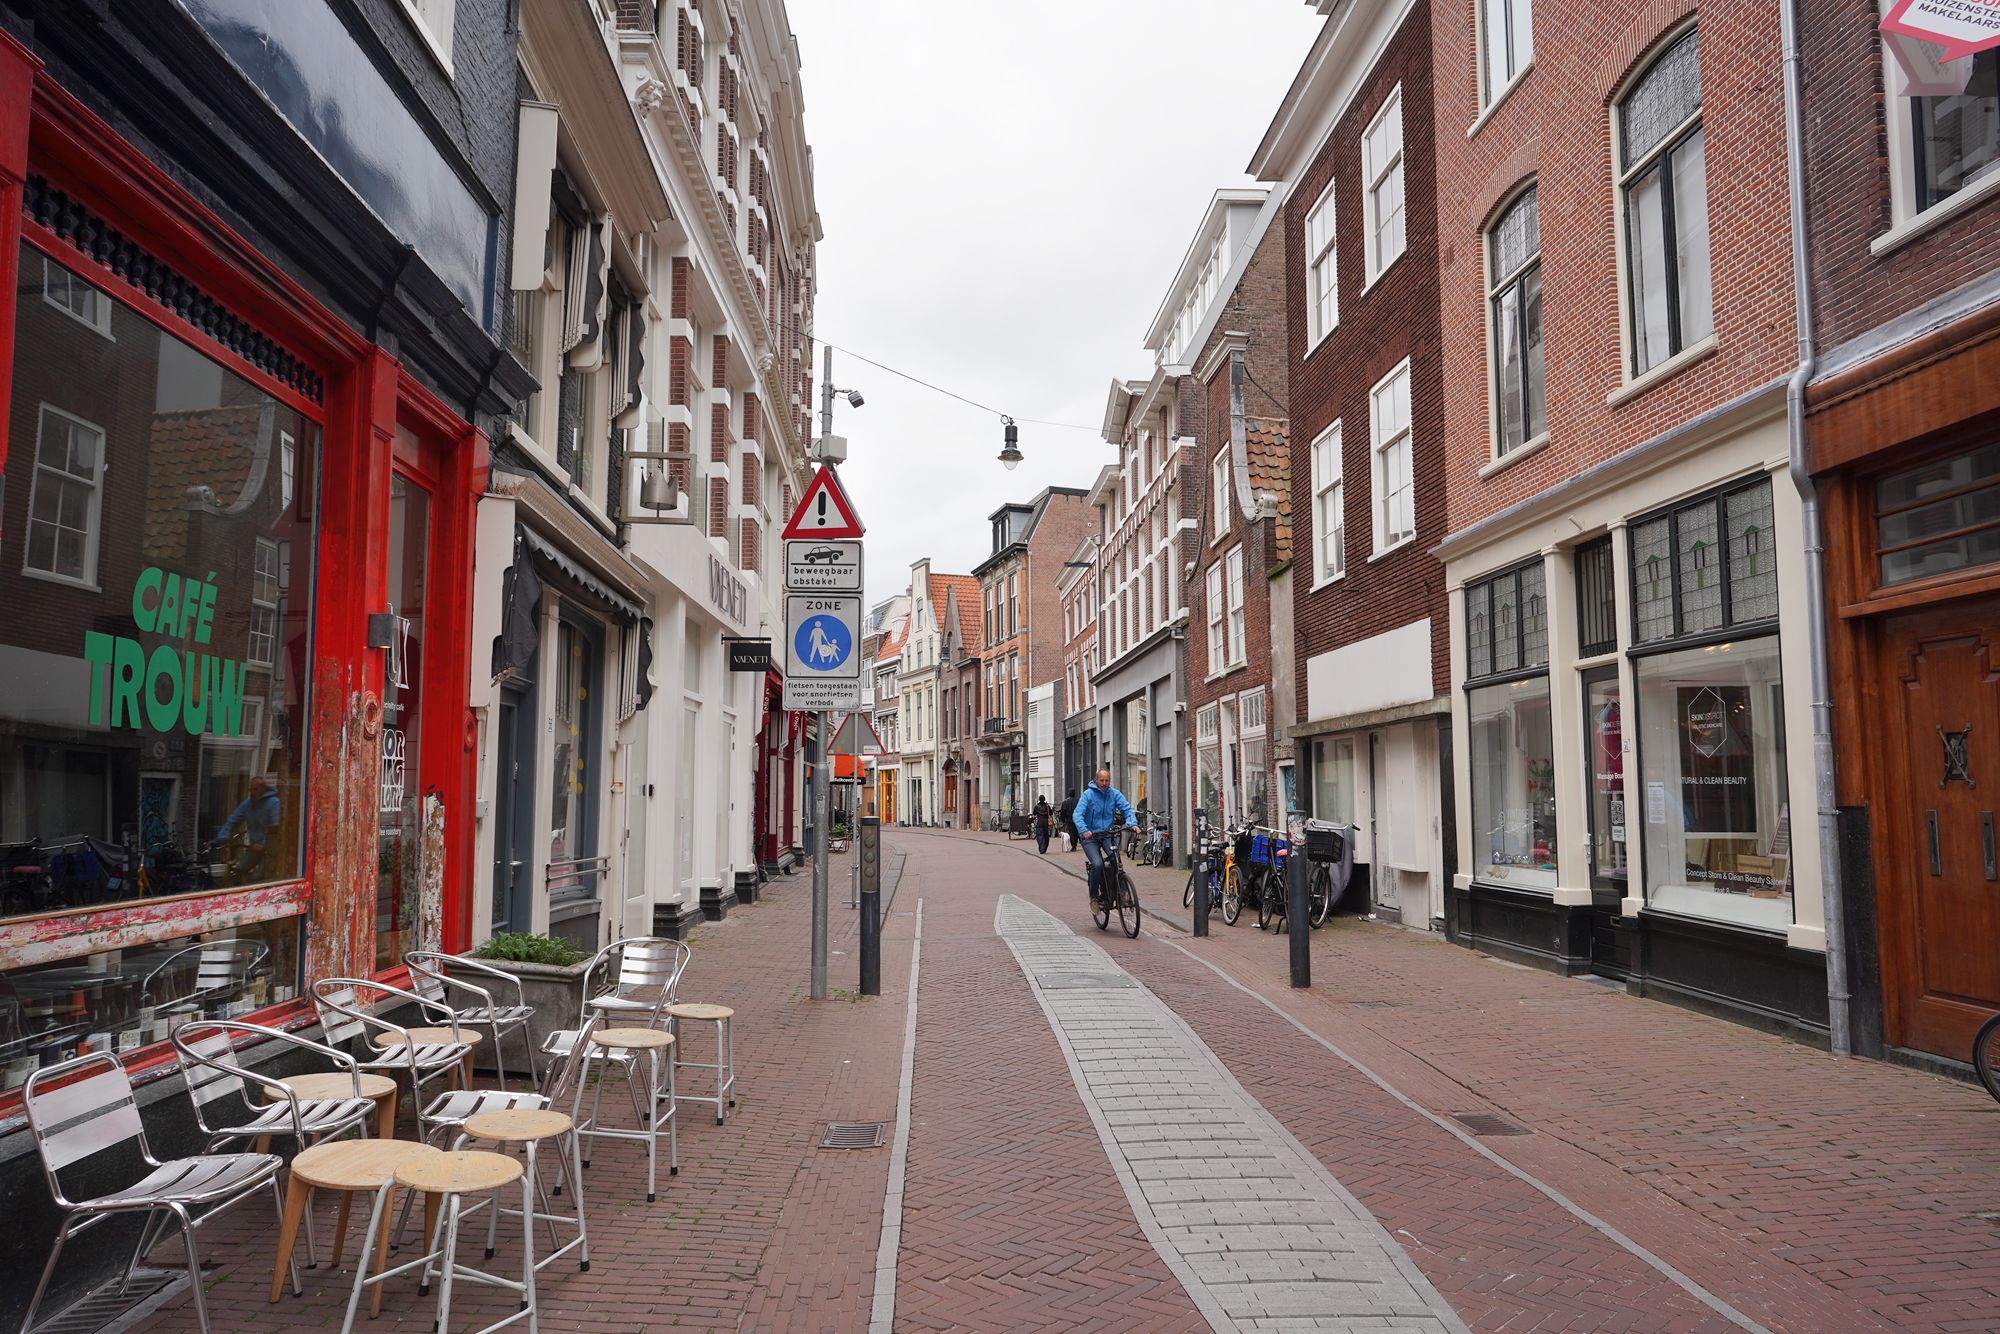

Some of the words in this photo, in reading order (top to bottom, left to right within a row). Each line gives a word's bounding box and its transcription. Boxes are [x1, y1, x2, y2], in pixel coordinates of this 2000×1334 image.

[1918, 3, 2000, 29] MAKELAARS
[1924, 0, 2000, 19] UIZENSTE
[794, 567, 853, 576] beweegbaar
[132, 566, 218, 645] CAFÉ
[806, 601, 841, 610] ZONE
[733, 655, 768, 664] VAENETI
[84, 630, 249, 737] TROUW
[381, 728, 406, 758] OR
[1679, 776, 1699, 785] TURAL
[1699, 776, 1704, 785] &
[1704, 776, 1723, 785] CLEAN
[1723, 776, 1747, 785] BEAUTY
[1686, 868, 1707, 880] Concept
[1708, 870, 1722, 879] Store
[1723, 872, 1727, 880] &
[1728, 872, 1744, 882] Clean
[1745, 874, 1766, 885] Beauty
